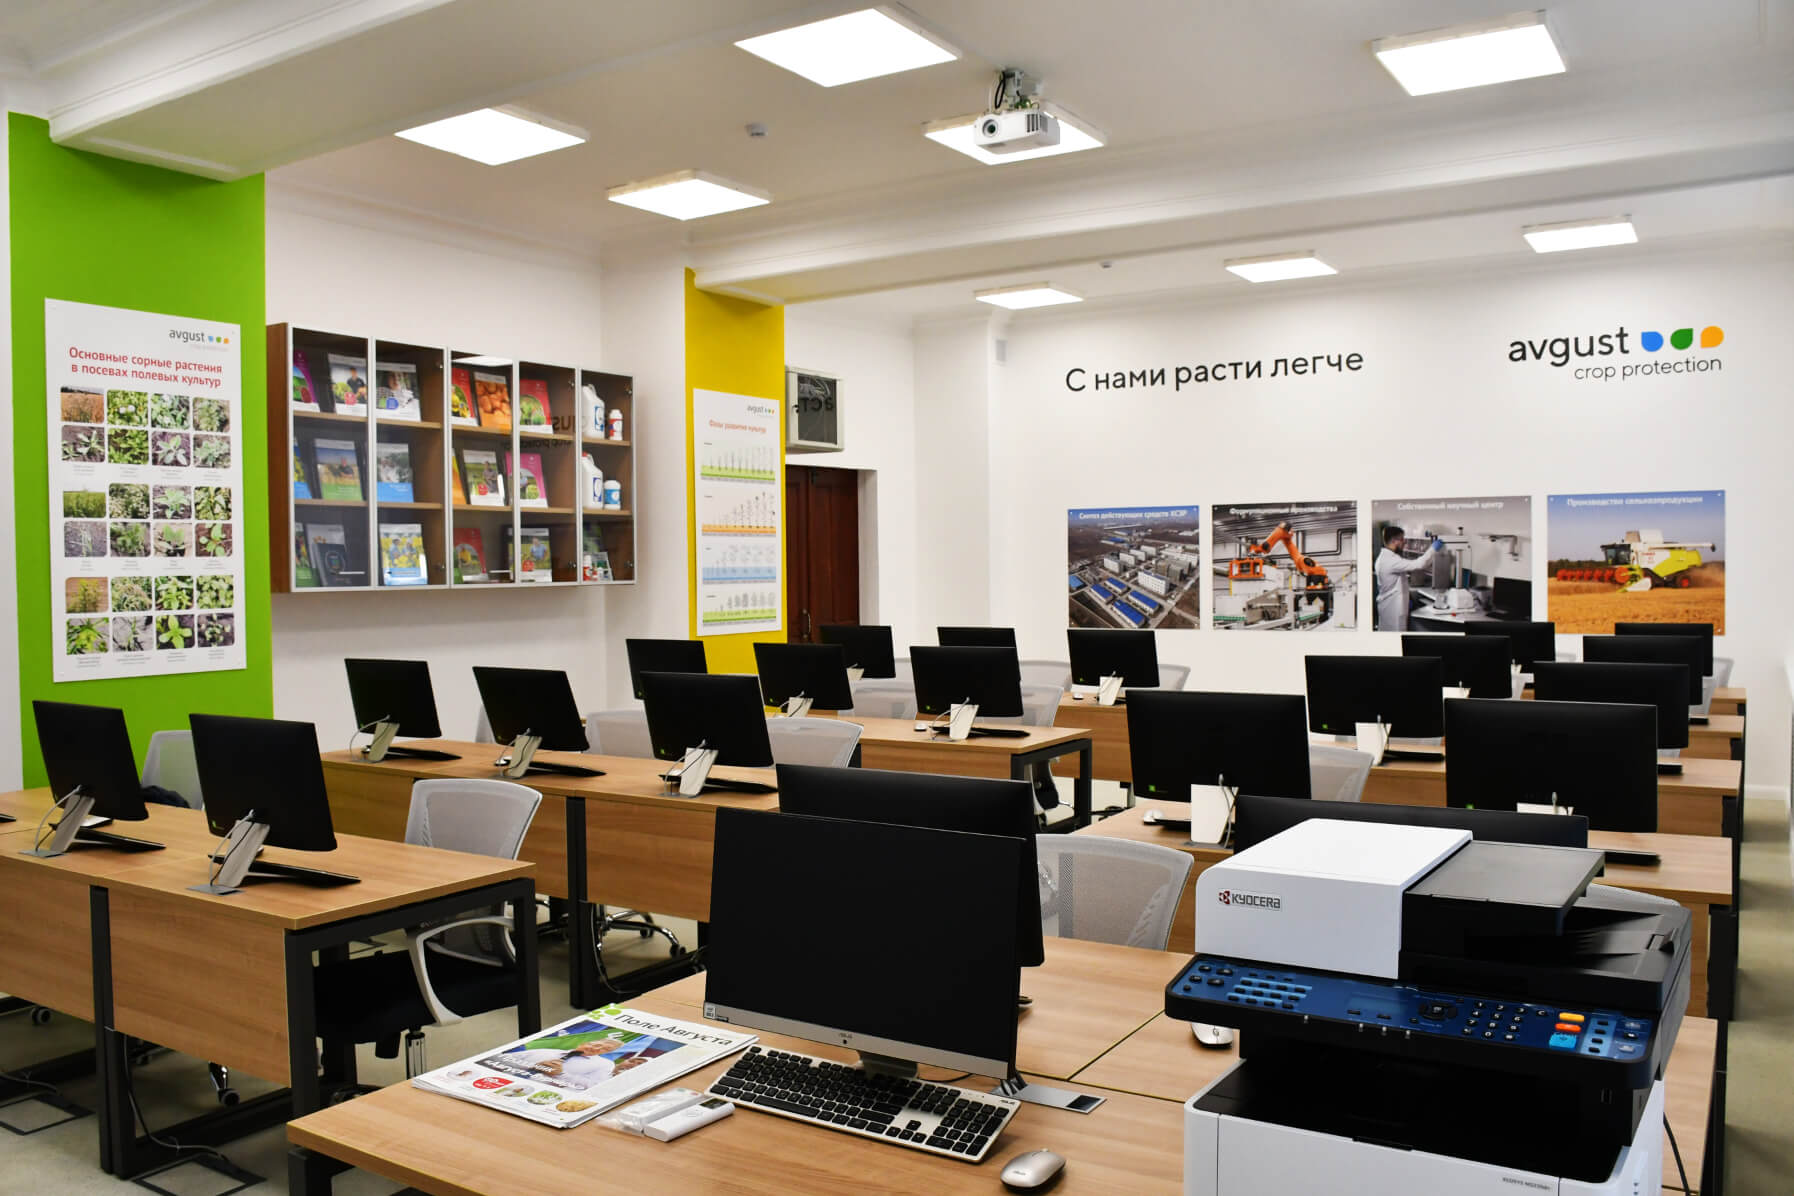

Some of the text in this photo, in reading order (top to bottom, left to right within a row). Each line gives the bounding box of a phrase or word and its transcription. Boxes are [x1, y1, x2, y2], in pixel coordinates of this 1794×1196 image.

[169, 329, 205, 343] avgust
[1508, 327, 1630, 367] avgust
[69, 346, 222, 374] Основные сорные растения
[1066, 353, 1364, 392] С нами расти легче
[1574, 356, 1723, 382] crop protection
[72, 363, 221, 389] в посевах полевых культур
[1398, 502, 1445, 511] Собственный
[1231, 893, 1281, 909] KYOCERA
[614, 1014, 733, 1046] Поле Августа
